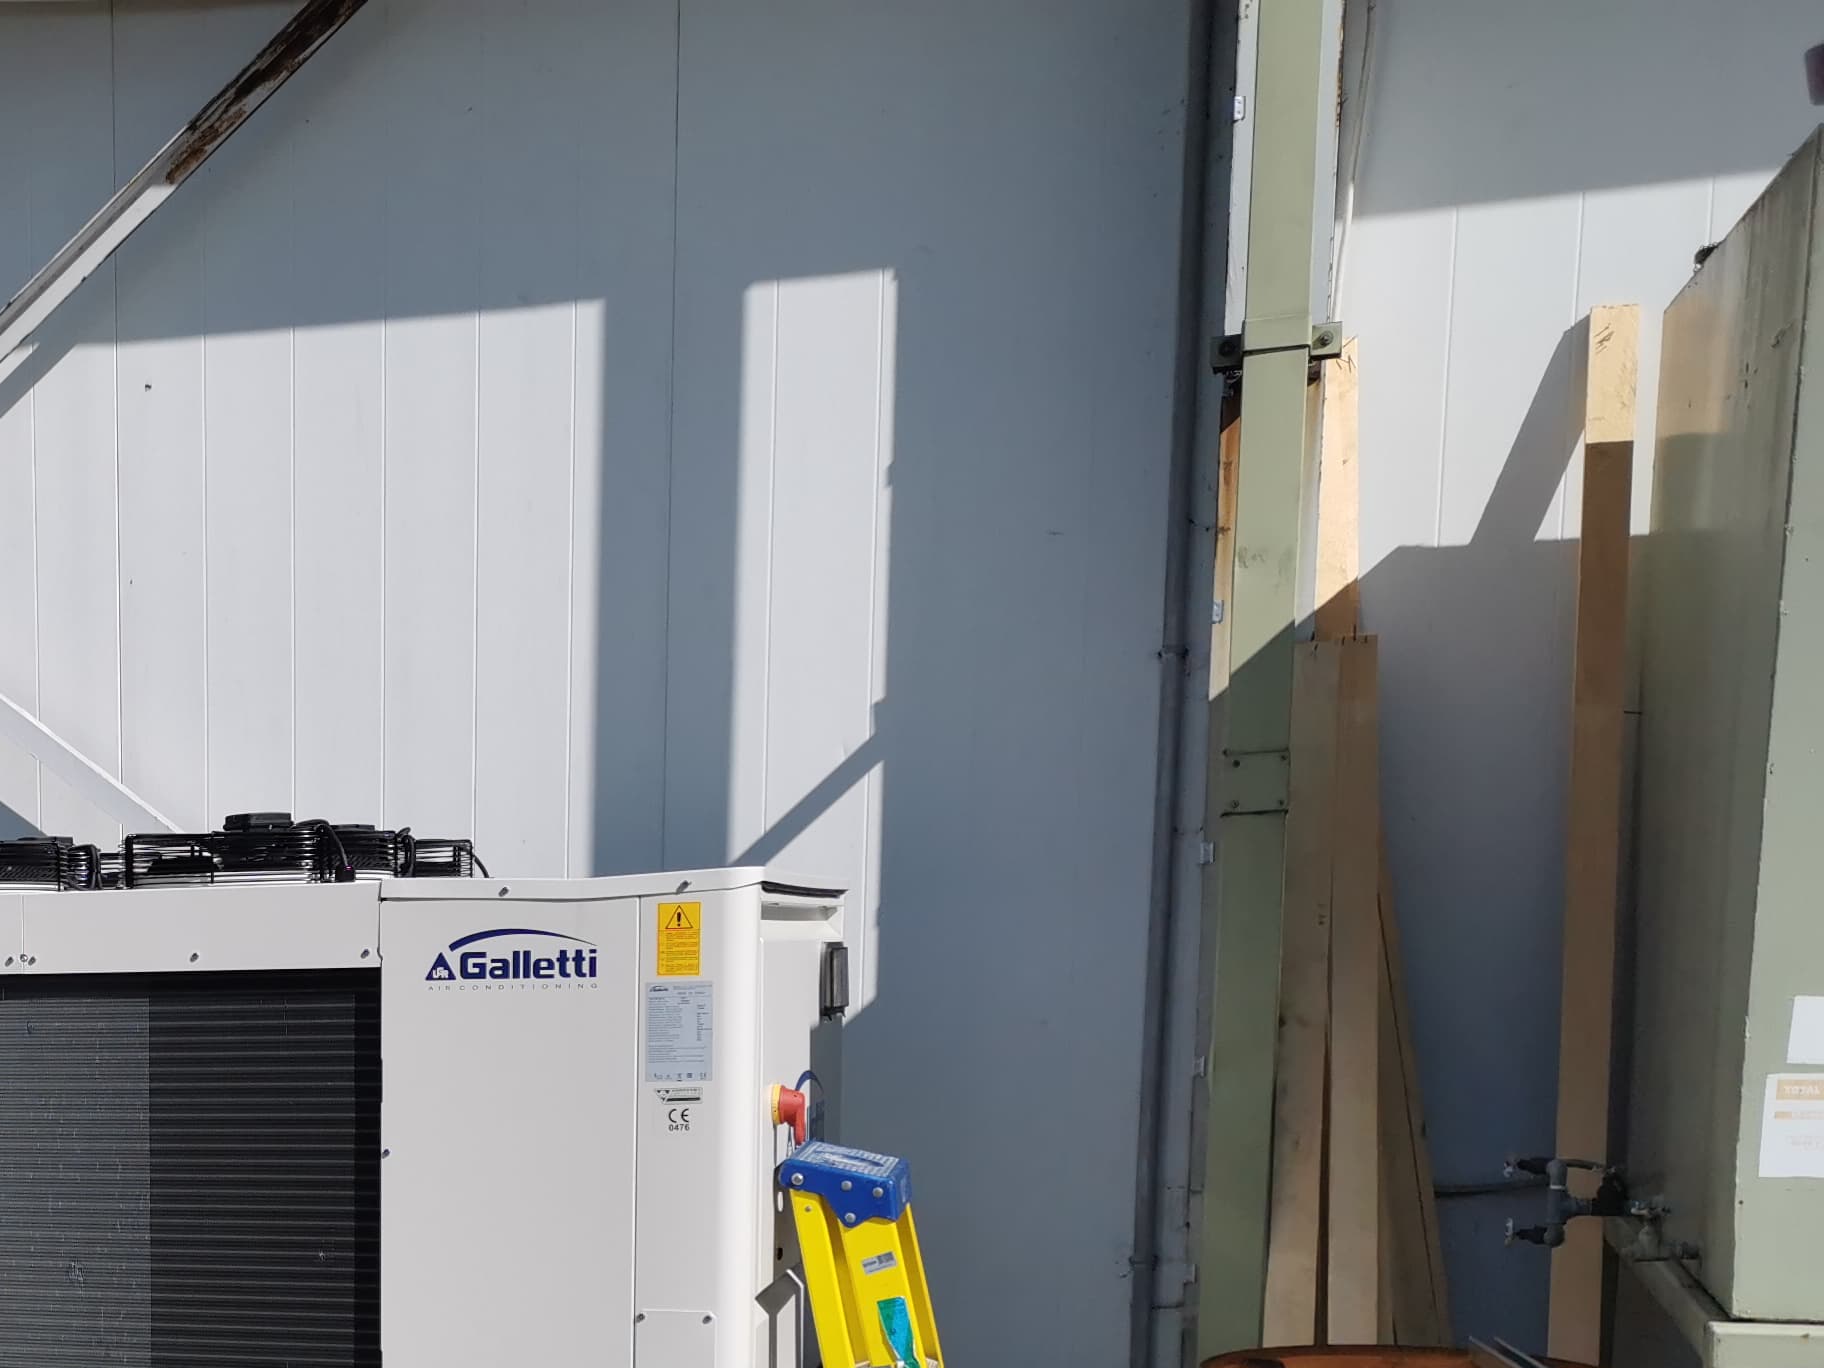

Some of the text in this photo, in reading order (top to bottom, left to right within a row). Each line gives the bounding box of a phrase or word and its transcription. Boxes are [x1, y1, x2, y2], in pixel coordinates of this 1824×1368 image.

[460, 949, 597, 980] Galletti
[459, 983, 598, 992] CONDITIONING
[668, 1124, 690, 1132] 0476
